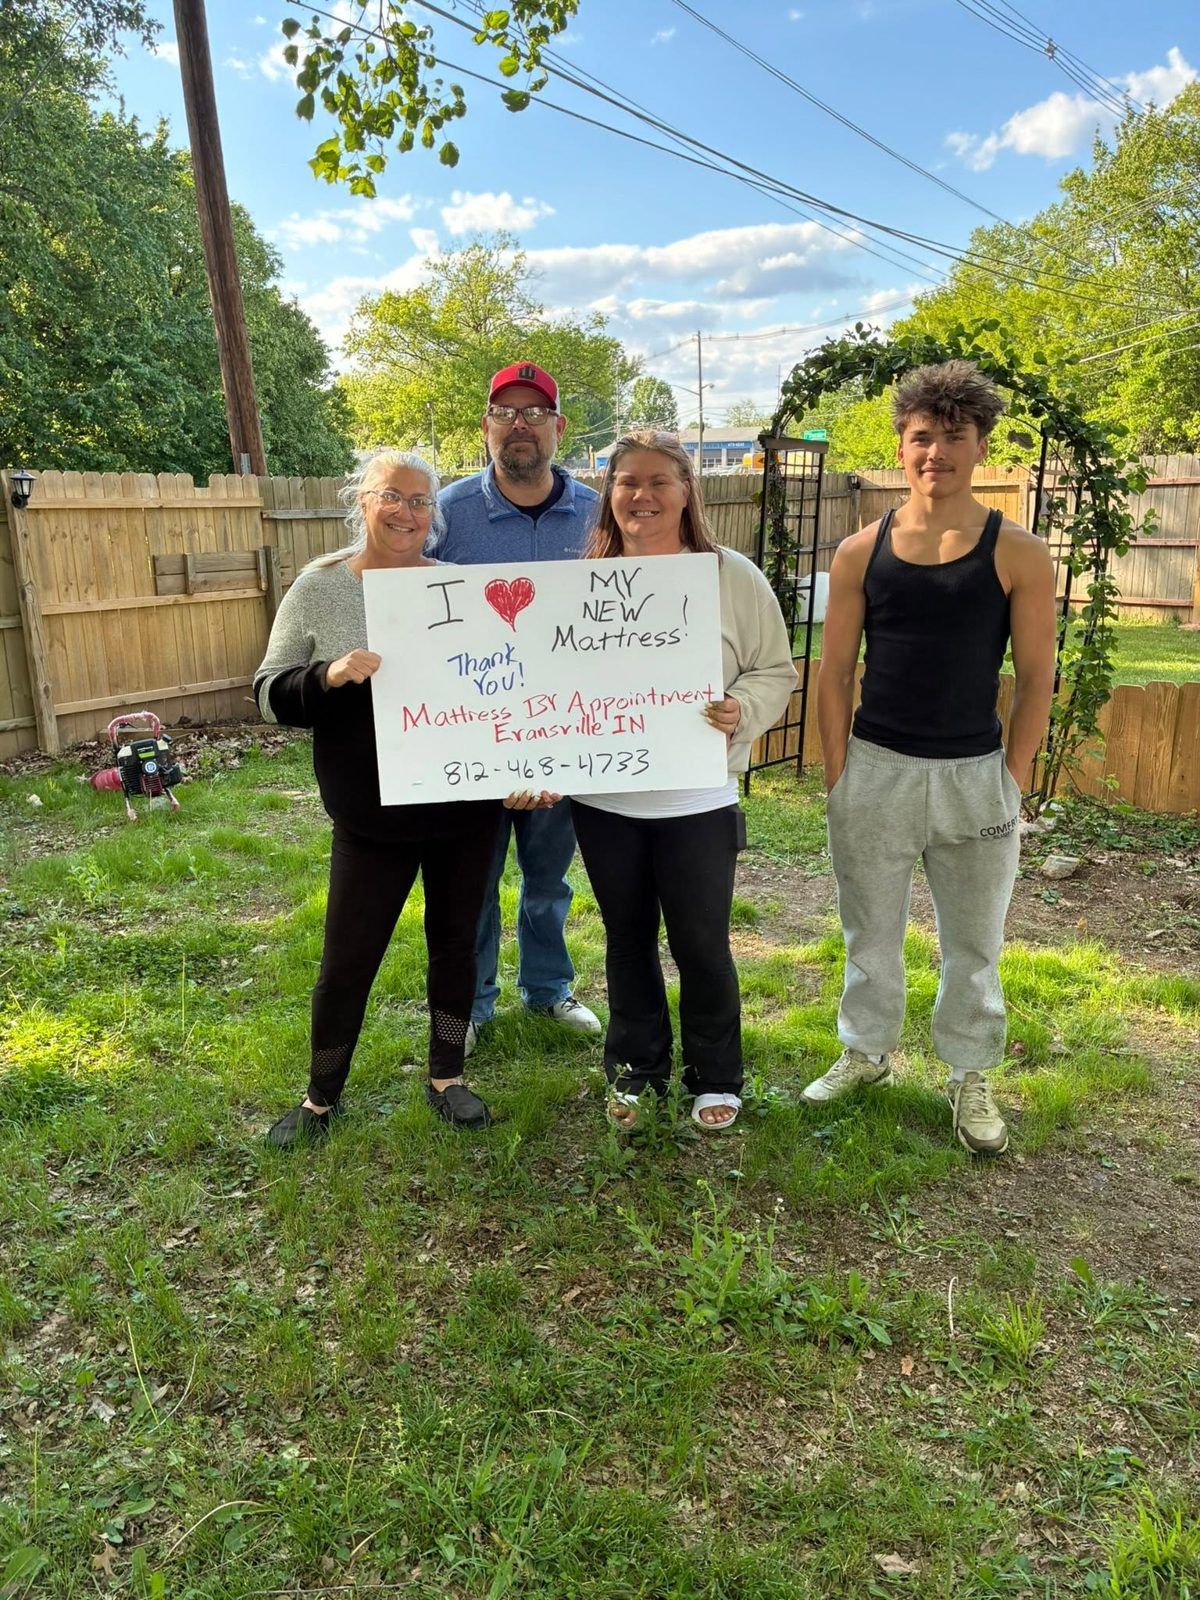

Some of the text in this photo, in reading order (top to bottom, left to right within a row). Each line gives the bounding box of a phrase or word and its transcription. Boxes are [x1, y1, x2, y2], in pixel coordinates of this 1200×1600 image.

[590, 567, 643, 600] MY
[427, 579, 466, 630] I
[582, 593, 656, 624] NEW
[447, 643, 517, 677] Thank
[402, 703, 513, 733] Mattress
[567, 683, 716, 726] Appointment
[611, 713, 647, 736] IN
[443, 748, 652, 786] 812-468-4733
